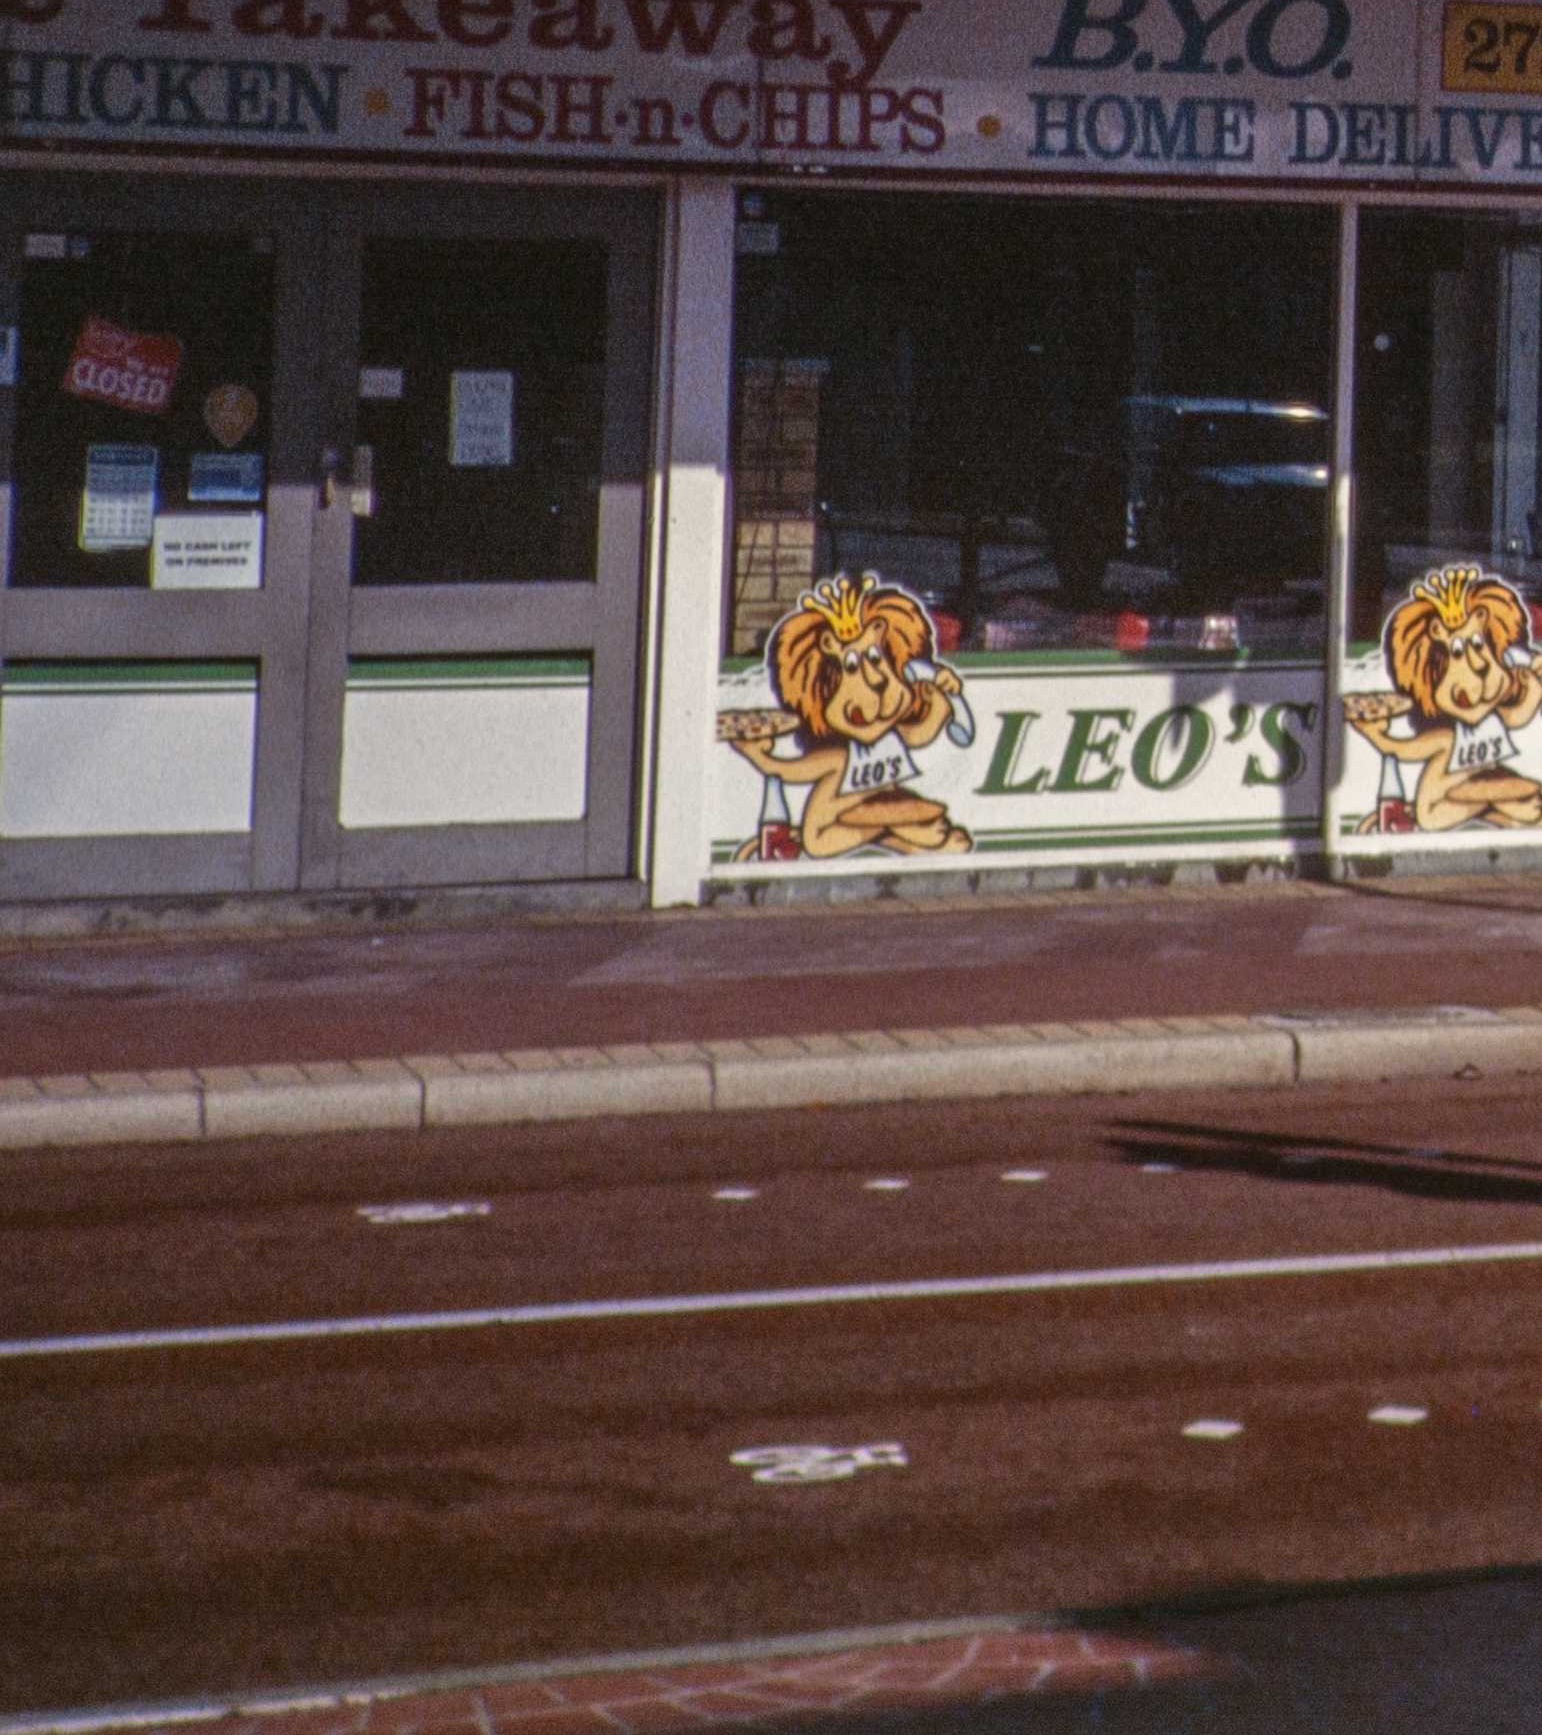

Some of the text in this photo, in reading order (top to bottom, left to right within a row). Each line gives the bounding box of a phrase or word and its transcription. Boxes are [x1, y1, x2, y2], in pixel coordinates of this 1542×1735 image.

[1028, 92, 1255, 164] HOME
[72, 358, 167, 404] CLOSED
[222, 541, 251, 552] LEFT
[972, 701, 1319, 797] LEO'S
[1457, 736, 1503, 767] LEO'S
[850, 755, 904, 786] LEO'S
